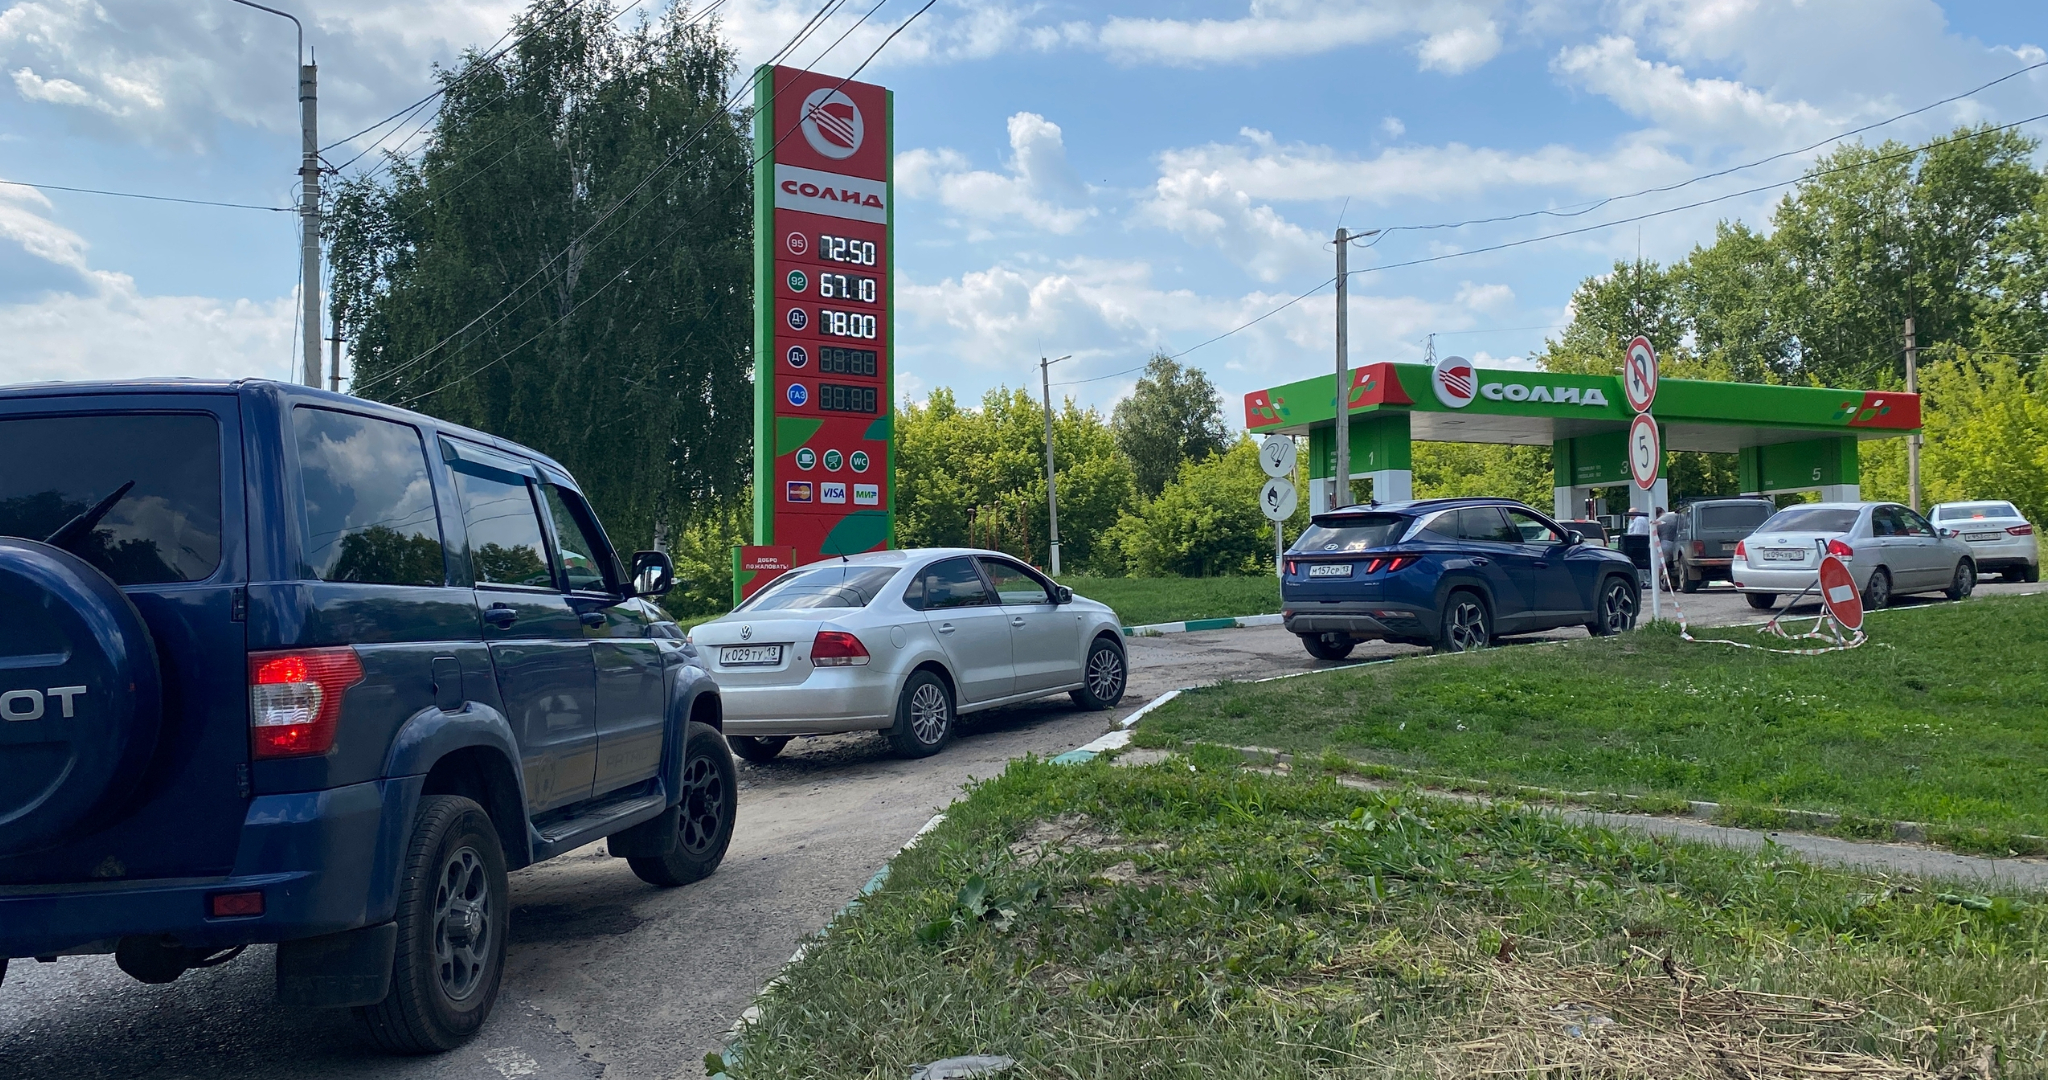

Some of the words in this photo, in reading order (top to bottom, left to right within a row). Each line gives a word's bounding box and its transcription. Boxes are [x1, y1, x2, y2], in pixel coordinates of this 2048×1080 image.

[781, 180, 884, 210] СОЛИД
[791, 238, 804, 248] 95
[821, 235, 875, 266] 72.50
[791, 276, 804, 286] 92
[820, 273, 876, 303] 67.10
[821, 310, 876, 339] 78.00
[790, 390, 806, 400] ГАЗ
[1481, 382, 1608, 407] СОЛИД
[1368, 451, 1374, 466] 1
[1638, 435, 1649, 469] 5
[853, 457, 867, 466] WC
[1620, 460, 1629, 475] 3
[1812, 467, 1821, 481] 5
[824, 488, 845, 498] VISA
[856, 490, 878, 498] МИР
[766, 646, 777, 657] 13
